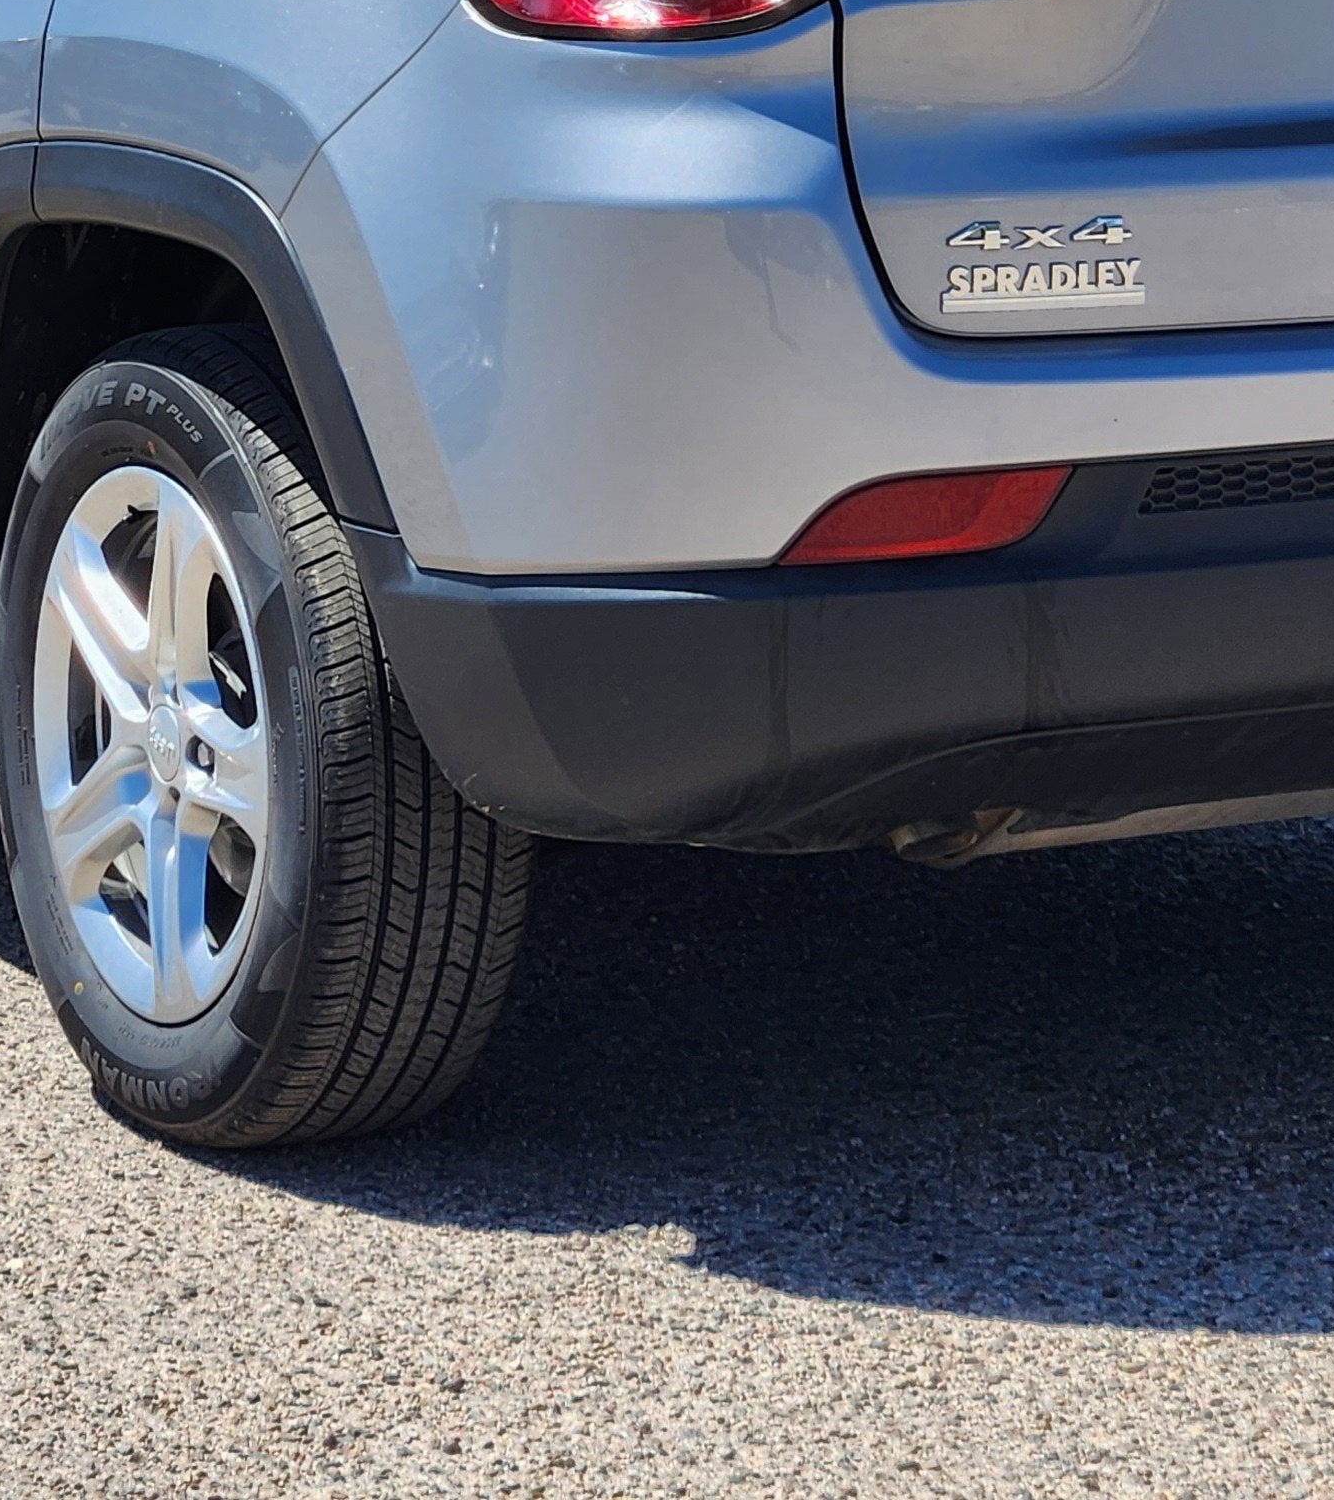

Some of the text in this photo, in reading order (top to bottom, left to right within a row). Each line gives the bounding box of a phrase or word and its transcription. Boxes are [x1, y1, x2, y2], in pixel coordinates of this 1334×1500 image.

[946, 214, 1133, 251] 4x4
[947, 256, 1142, 298] SPRADLEY
[124, 381, 167, 416] PT
[165, 403, 204, 444] PLUS
